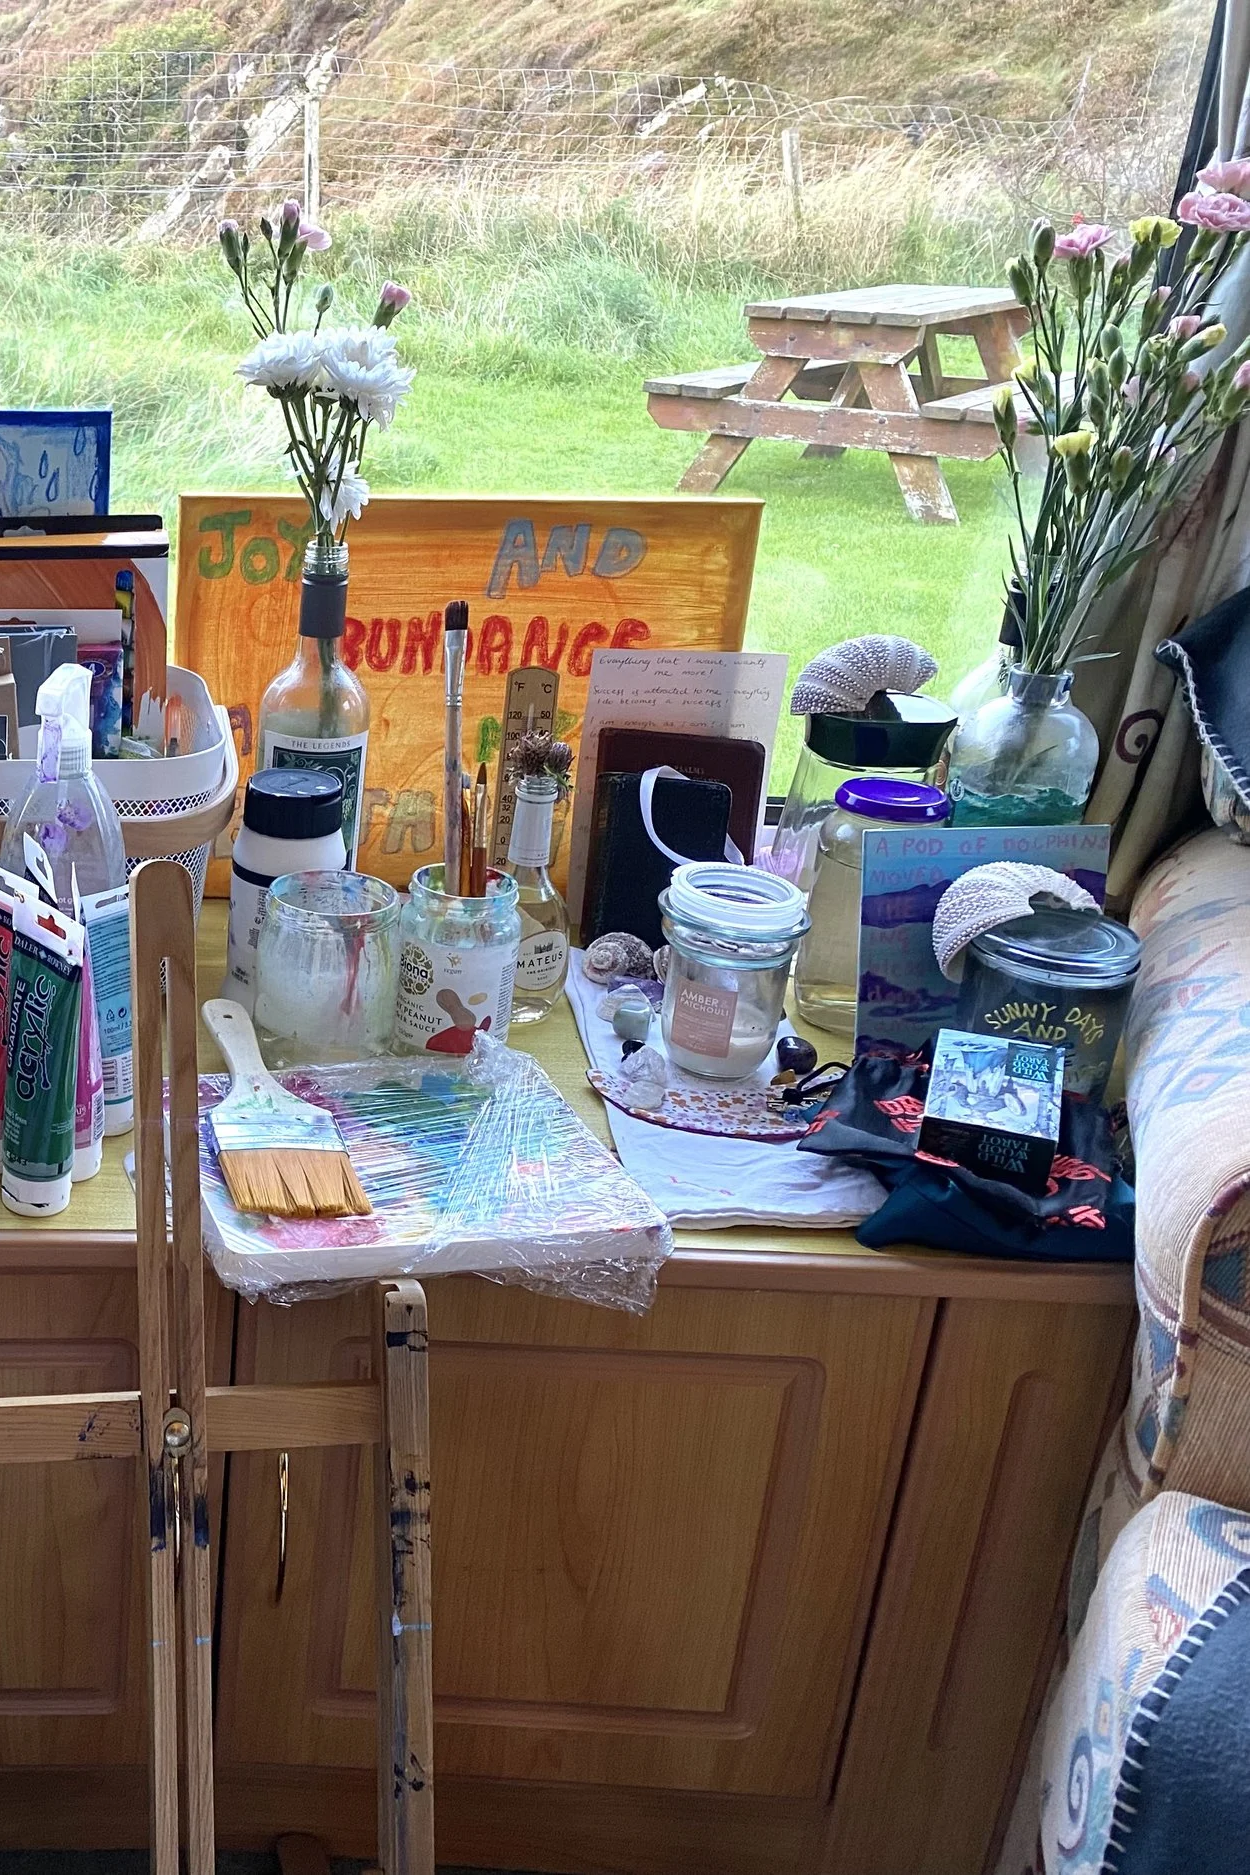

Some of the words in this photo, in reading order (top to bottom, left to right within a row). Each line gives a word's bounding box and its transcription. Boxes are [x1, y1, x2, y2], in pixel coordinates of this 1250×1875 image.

[198, 509, 316, 585] JOY
[486, 518, 647, 599] AND
[599, 655, 651, 672] Everything
[656, 656, 680, 665] that
[733, 658, 767, 668] wants
[654, 669, 671, 677] me
[682, 669, 713, 677] more!
[593, 685, 625, 696] Success
[644, 686, 688, 696] attracted
[693, 686, 703, 695] to
[706, 687, 722, 696] me
[508, 711, 522, 719] 120
[540, 711, 551, 719] 50
[506, 732, 520, 740] 100
[291, 741, 308, 749] THE
[313, 741, 351, 750] LEGENDS
[502, 794, 513, 803] 40
[502, 804, 511, 812] 32
[500, 815, 511, 824] 20
[500, 836, 506, 844] 0
[876, 838, 889, 856] A
[903, 838, 944, 856] POD
[959, 837, 988, 856] OF
[1002, 834, 1111, 853] DOLPHINS
[496, 857, 507, 866] 20
[14, 936, 39, 956] DALER
[46, 955, 73, 976] ROWNEY
[516, 950, 563, 969] MATEUS
[681, 988, 719, 1008] AMBER
[680, 997, 729, 1017] PATCHOULI
[404, 1006, 442, 1025] PEANUT
[984, 1002, 1058, 1030] SUNNY
[1064, 1007, 1105, 1044] DAYS
[410, 1020, 436, 1034] SAUCE
[1013, 1021, 1067, 1041] AND
[16, 975, 52, 1101] acrylic
[1013, 1061, 1050, 1073] WOOD
[1014, 1054, 1050, 1067] TAROT
[1013, 1067, 1049, 1082] WILD
[982, 1133, 1031, 1151] TAROT
[978, 1142, 1029, 1160] WOOD
[978, 1151, 1026, 1174] WILD
